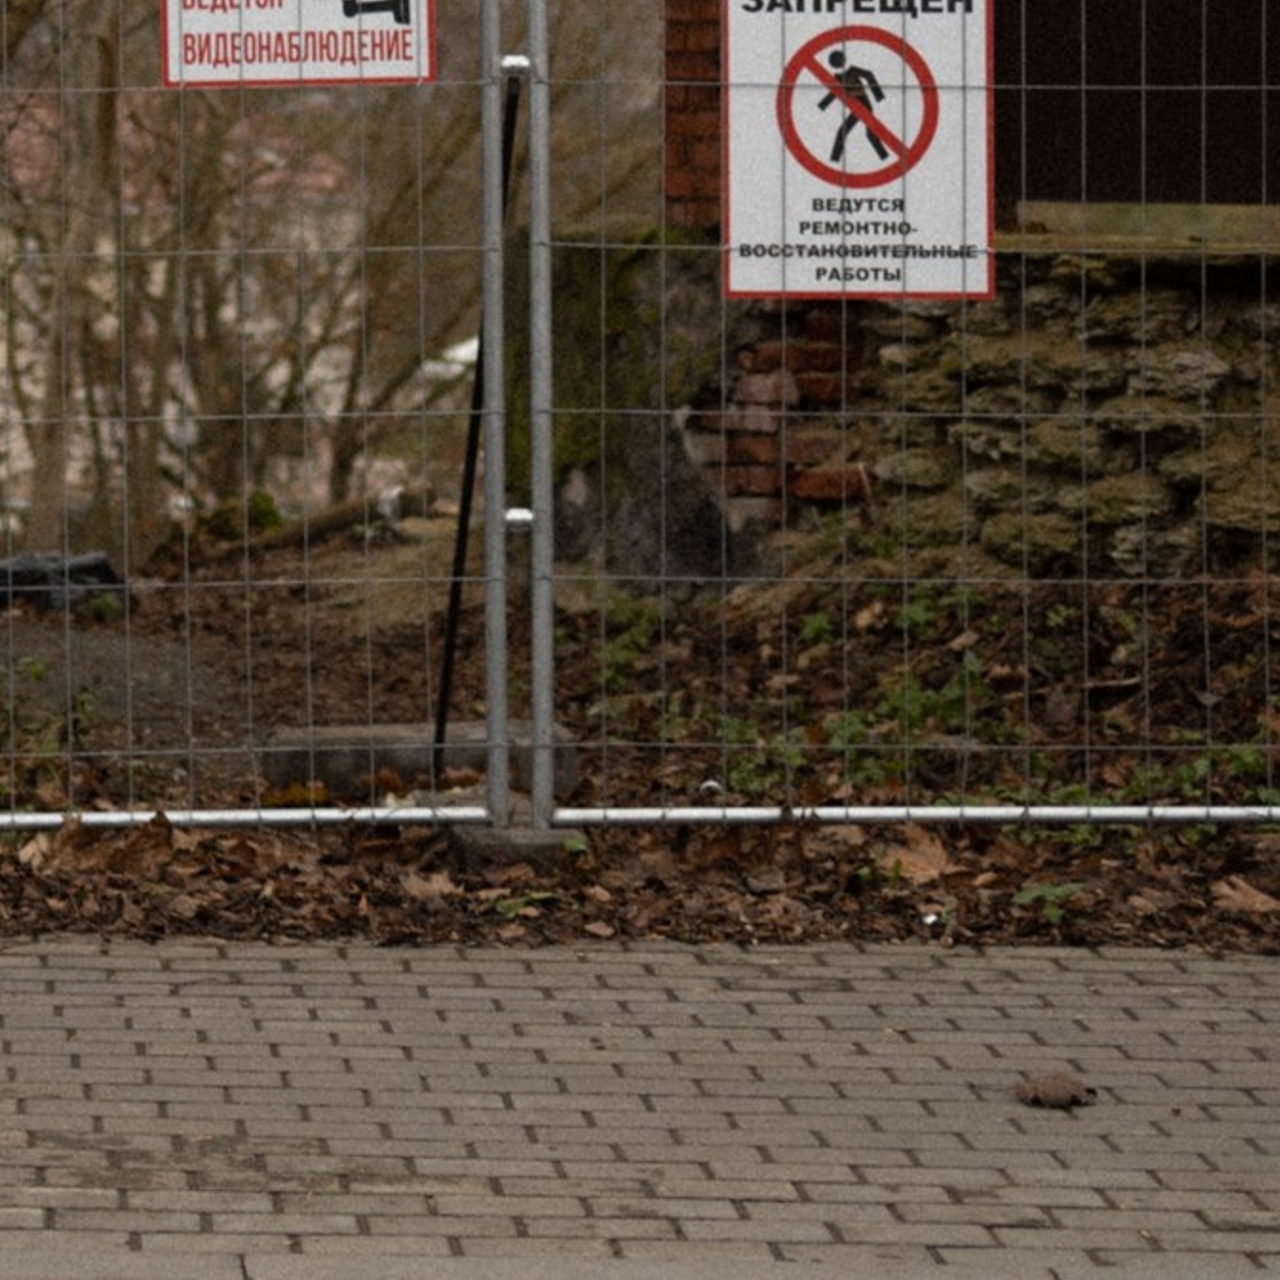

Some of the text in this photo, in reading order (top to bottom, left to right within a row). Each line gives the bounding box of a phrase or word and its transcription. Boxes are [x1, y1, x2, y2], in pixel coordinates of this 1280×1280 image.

[183, 29, 413, 67] ВИДЕОНАБЛЮДЕНИЕ
[812, 198, 905, 214] ВЕДУТСЯ
[799, 221, 918, 235] РЕМОНТНО-
[739, 243, 978, 259] ВОССТАНОВИТЕЛЬНЫЕ
[815, 267, 902, 282] РАБОТЫ
